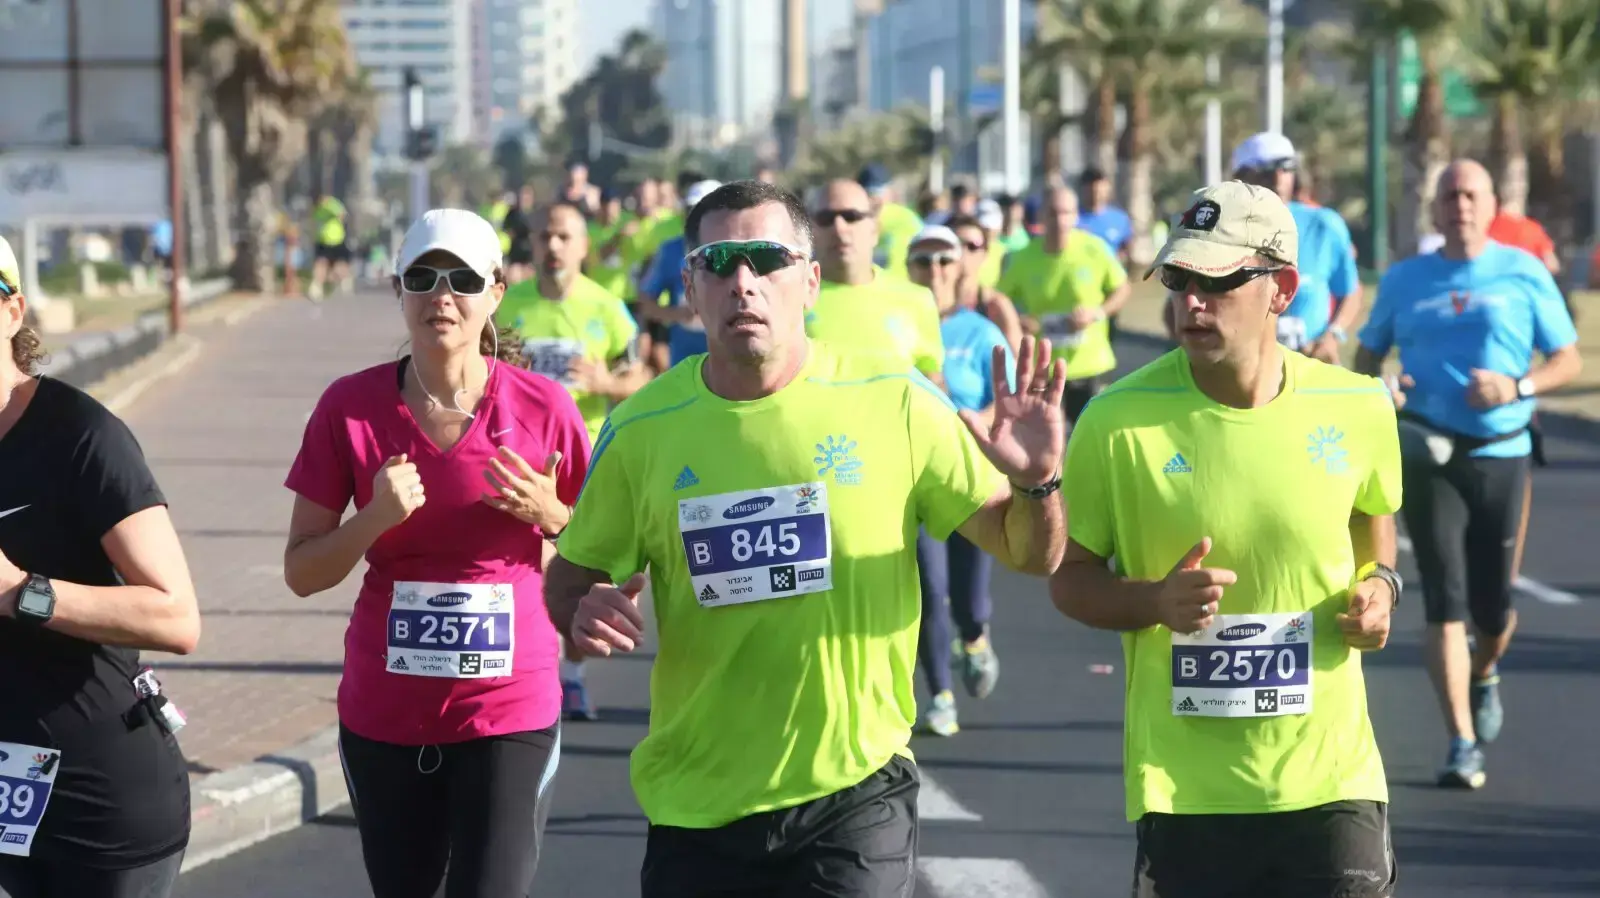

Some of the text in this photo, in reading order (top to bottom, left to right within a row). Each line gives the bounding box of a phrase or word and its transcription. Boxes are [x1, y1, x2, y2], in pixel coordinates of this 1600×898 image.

[1162, 464, 1192, 473] adidas
[729, 501, 769, 514] SAMSUNG
[693, 522, 801, 565] B 845
[800, 570, 822, 582] מרתון
[432, 595, 468, 603] SAMSUNG
[395, 614, 495, 645] B 2571
[1222, 627, 1261, 636] SAMSUNG
[1181, 648, 1296, 681] B 2570
[1281, 695, 1303, 705] מרתון
